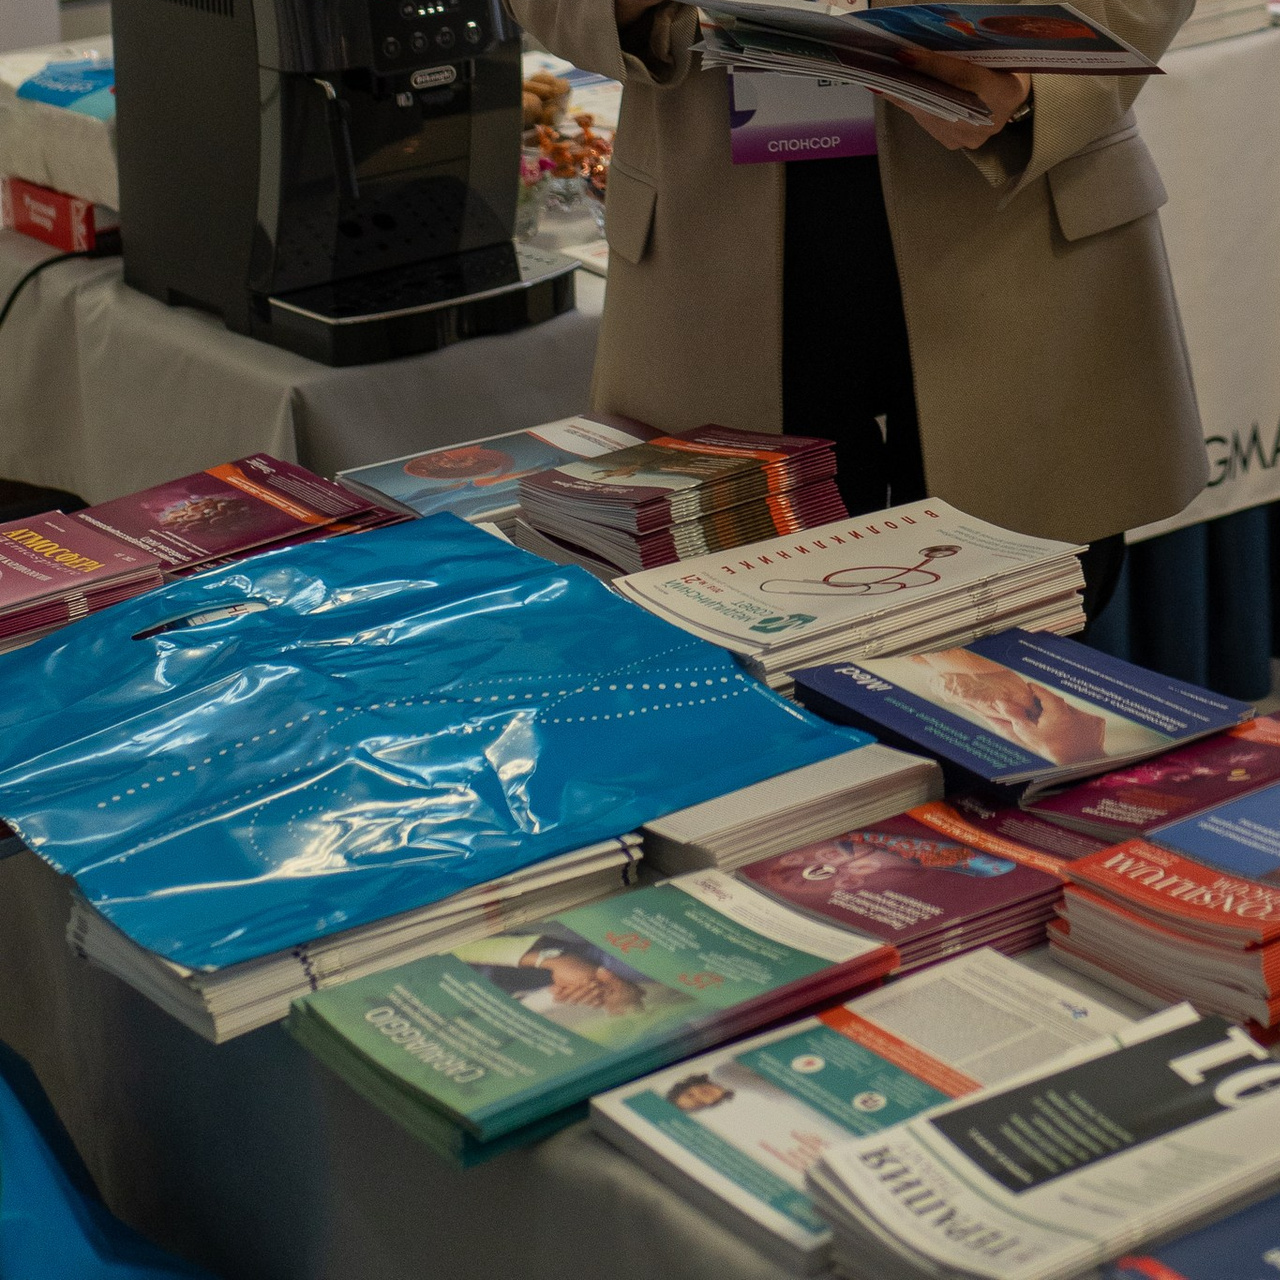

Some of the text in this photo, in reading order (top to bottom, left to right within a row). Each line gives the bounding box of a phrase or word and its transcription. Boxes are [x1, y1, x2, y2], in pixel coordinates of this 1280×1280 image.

[768, 136, 840, 152] СПОНСОР
[2, 528, 105, 573] АТМОСФЕРА
[719, 516, 918, 576] ПОЛИКЛИНИКЕ
[832, 664, 893, 692] iMed
[364, 1006, 486, 1085] CARAVAGGIO
[859, 1146, 1020, 1257] ТЕРАПИЯ
